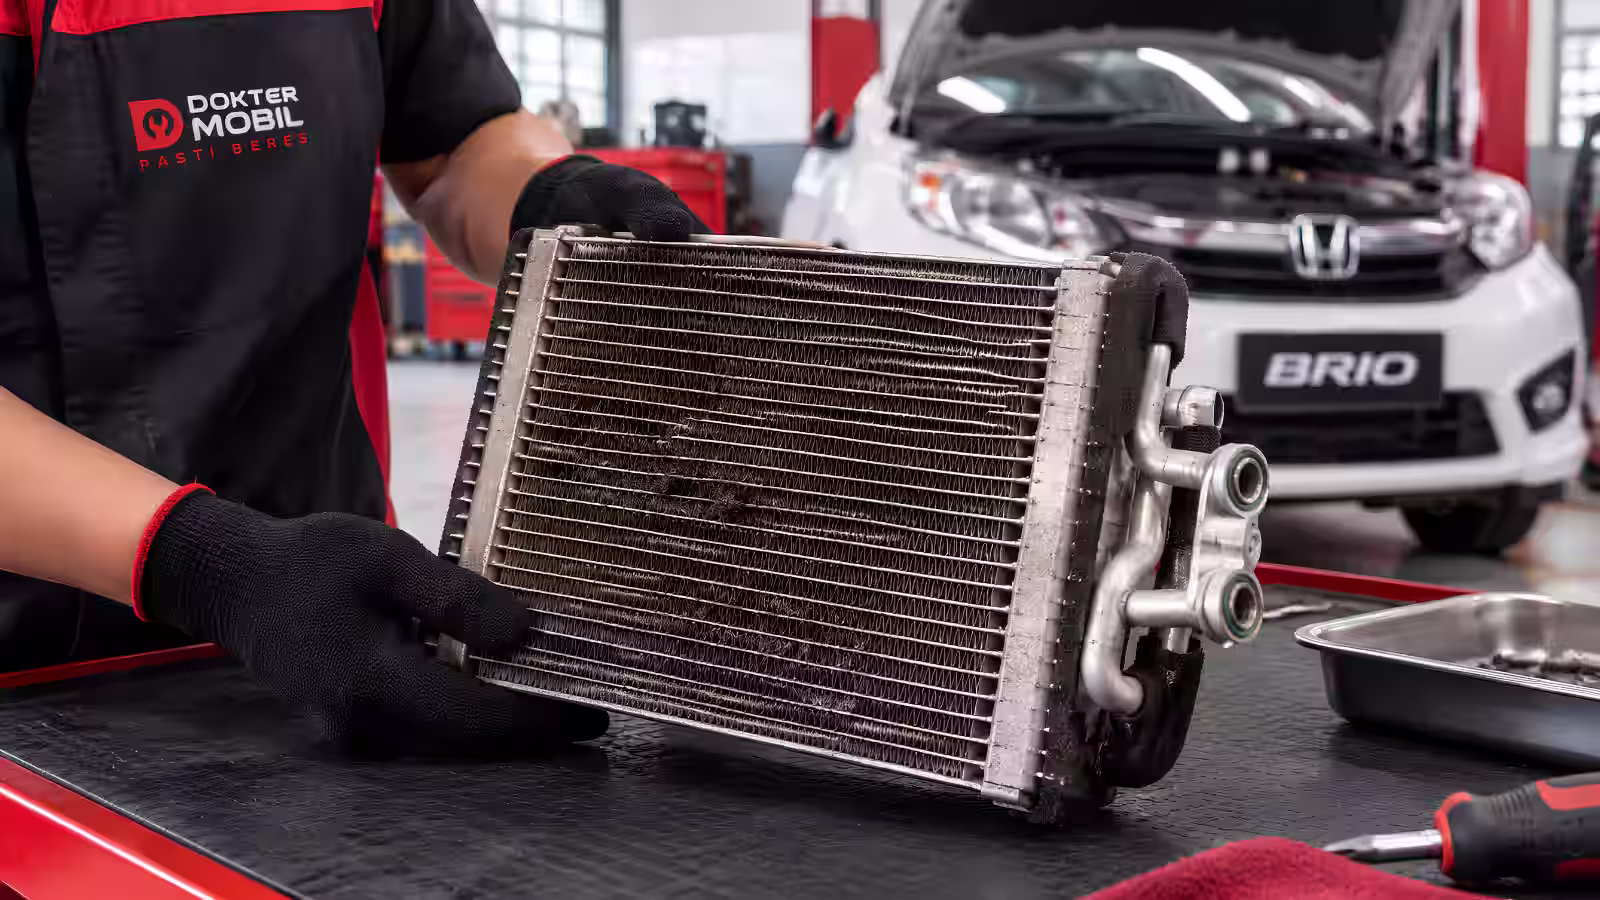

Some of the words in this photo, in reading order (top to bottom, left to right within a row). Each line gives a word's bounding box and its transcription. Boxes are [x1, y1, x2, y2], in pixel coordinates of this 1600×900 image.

[187, 86, 299, 114] DOKTER
[191, 106, 304, 142] MOBIL
[138, 145, 215, 172] PASTI
[231, 132, 308, 155] BERES
[1264, 352, 1419, 387] BRIO
